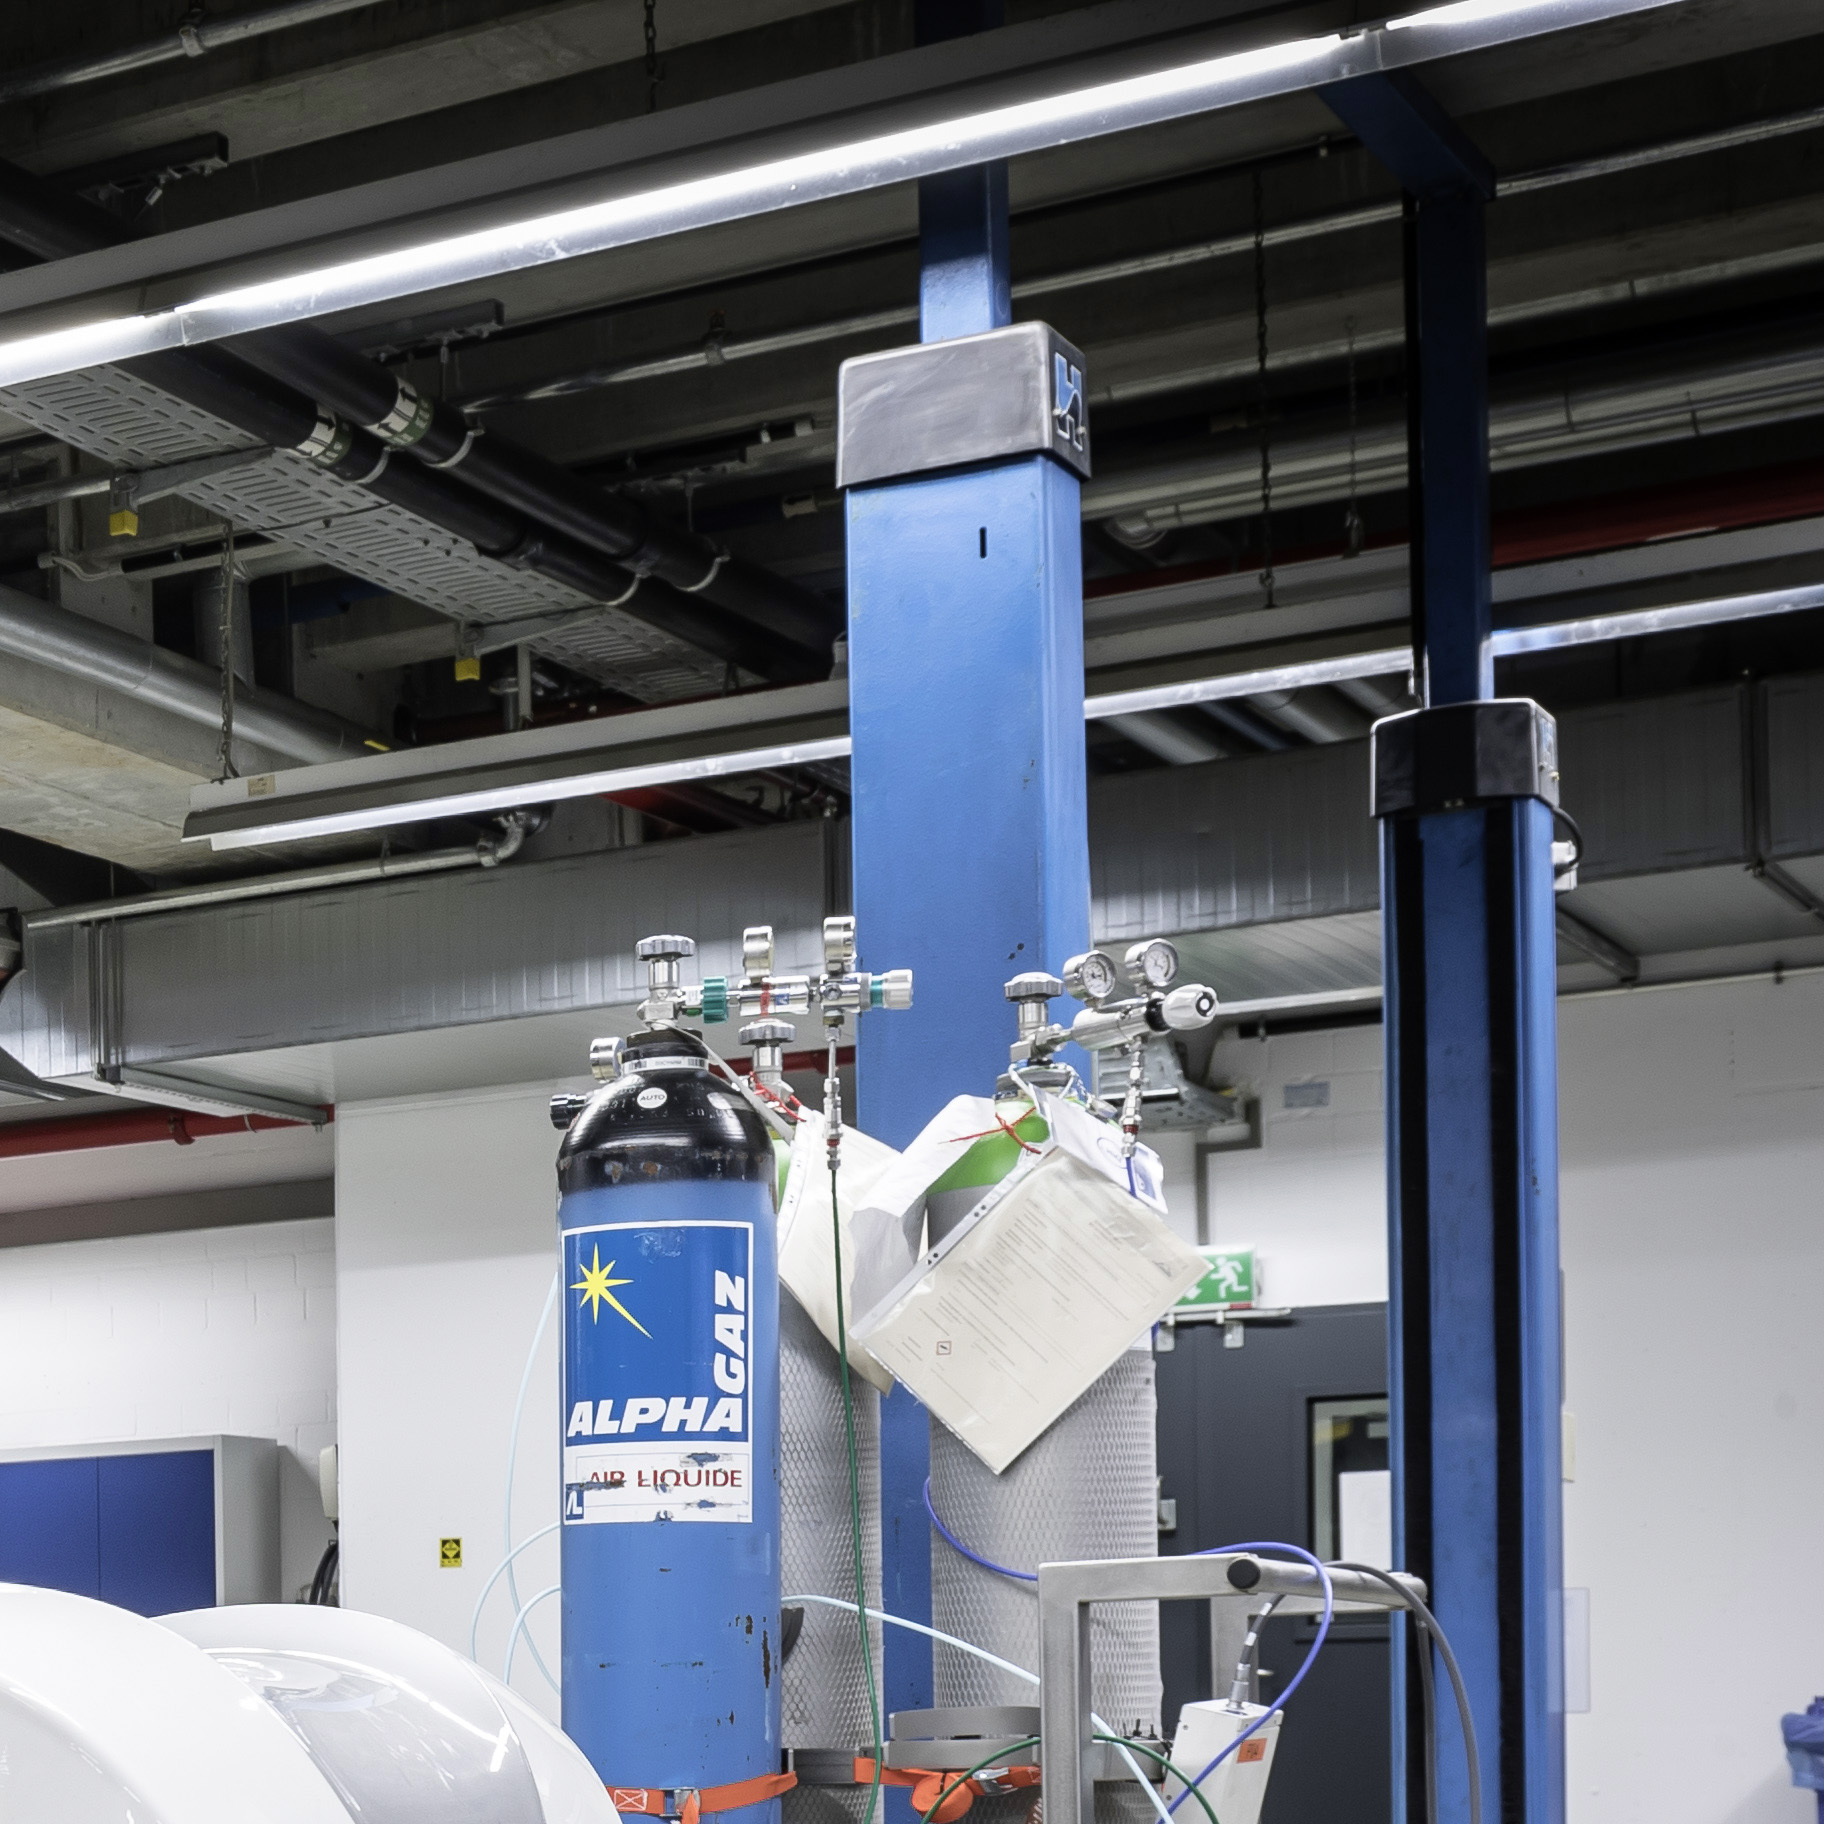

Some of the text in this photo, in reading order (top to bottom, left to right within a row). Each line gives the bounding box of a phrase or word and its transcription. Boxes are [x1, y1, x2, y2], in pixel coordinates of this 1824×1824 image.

[639, 1093, 665, 1102] AUTO
[713, 1269, 746, 1394] GAZ
[566, 1397, 744, 1438] ALPHA
[590, 1468, 743, 1488] AIR LIQUIDE
